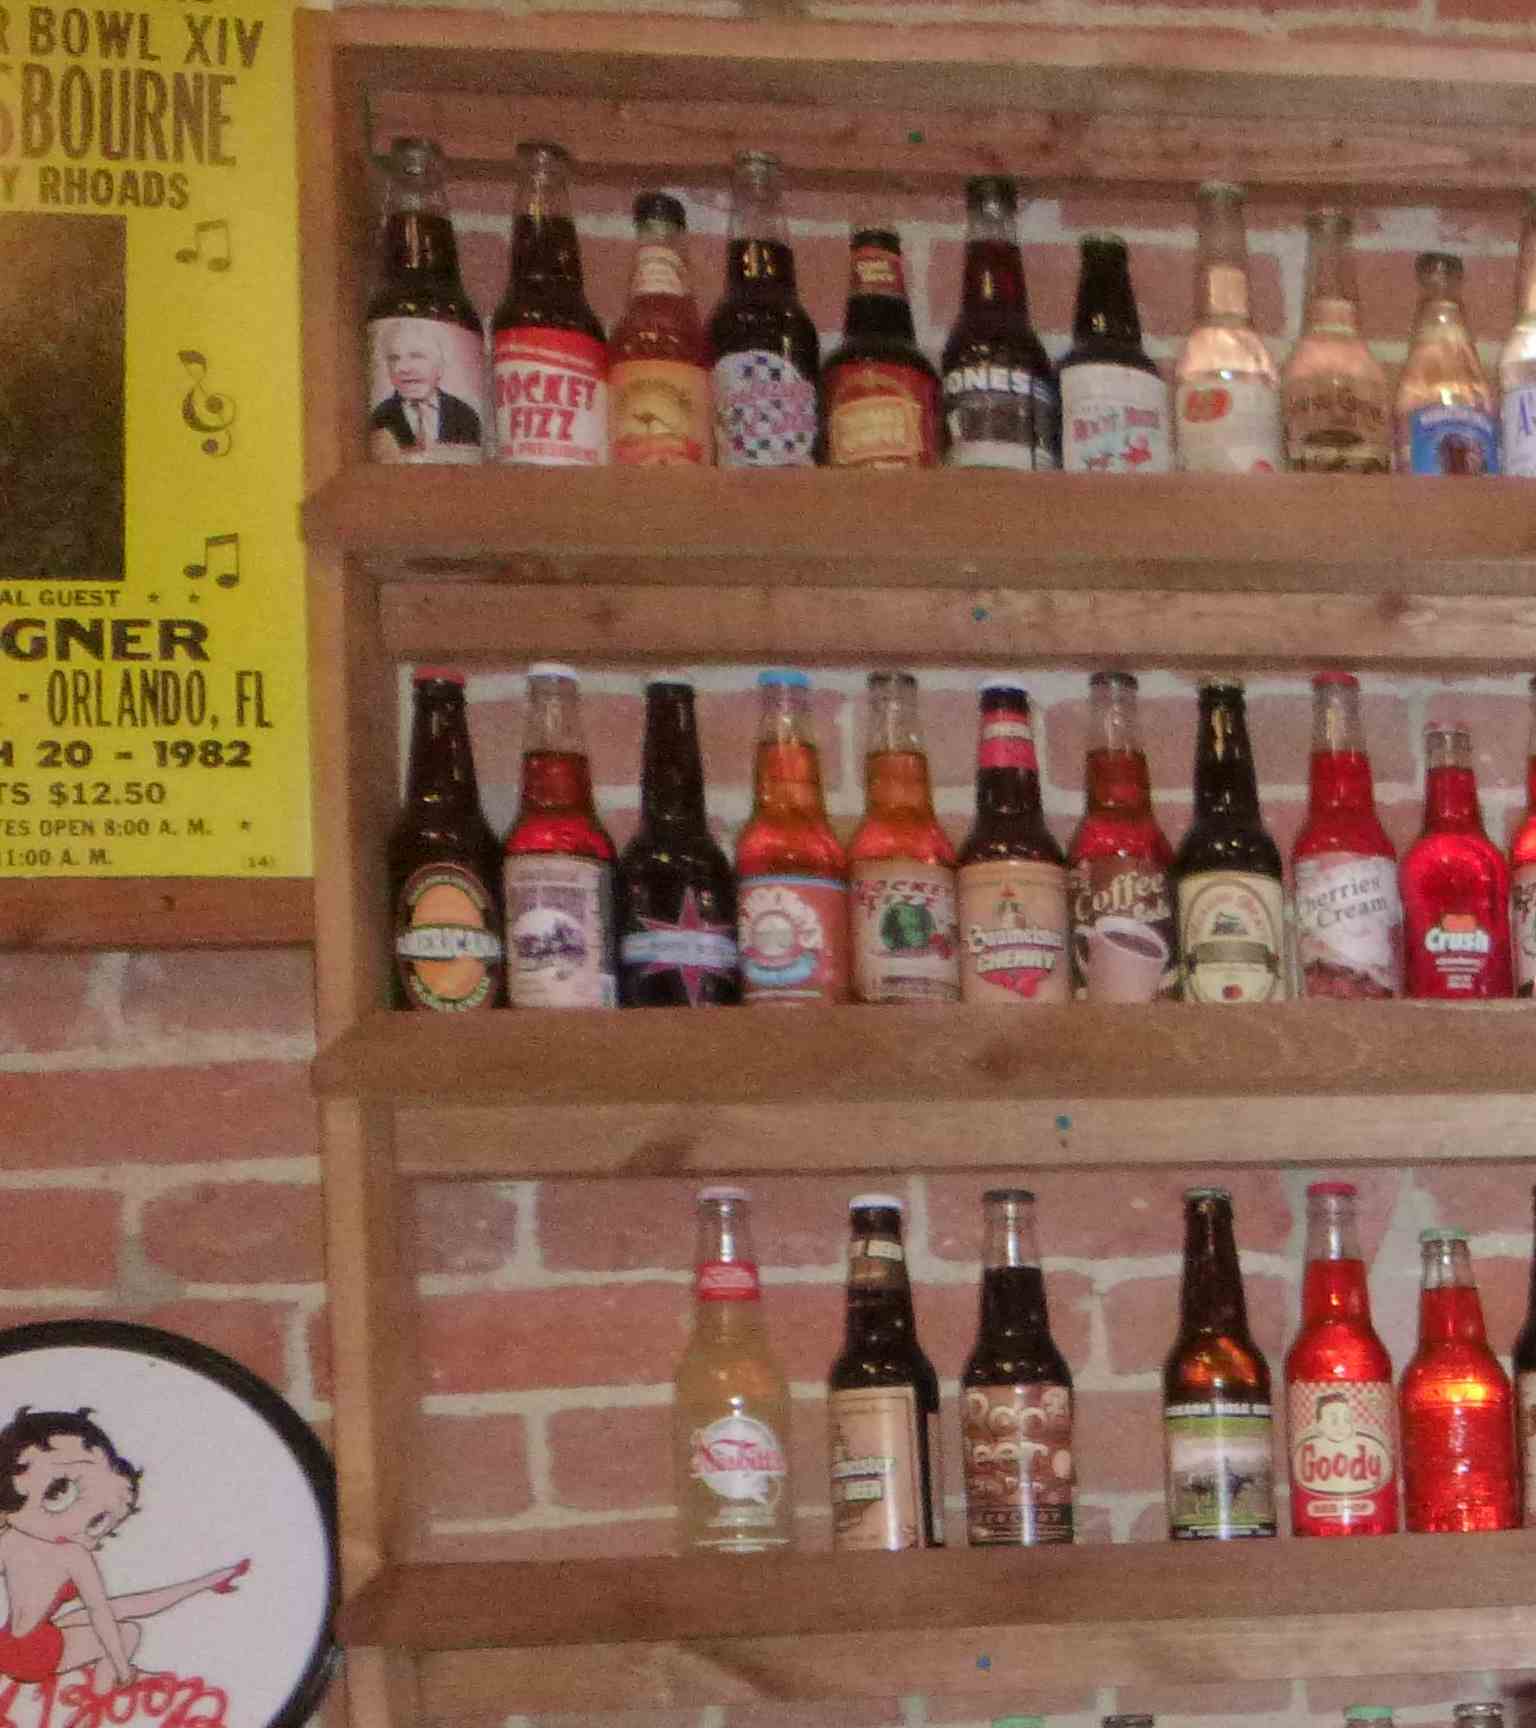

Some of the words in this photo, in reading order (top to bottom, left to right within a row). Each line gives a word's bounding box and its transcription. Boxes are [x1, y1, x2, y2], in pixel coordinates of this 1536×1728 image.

[29, 10, 161, 61] BOWL
[184, 18, 264, 70] XIV
[39, 168, 191, 210] RHOADS
[510, 407, 575, 442] FIZZ
[38, 588, 122, 608] GUEST
[47, 669, 220, 731] ORLANDO,
[235, 670, 274, 729] FL
[35, 740, 94, 769] 20
[154, 739, 253, 770] 1982
[48, 780, 167, 808] $12.50
[40, 818, 96, 838] OPEN
[1299, 876, 1380, 914] herries
[1300, 1443, 1381, 1487] Goody
